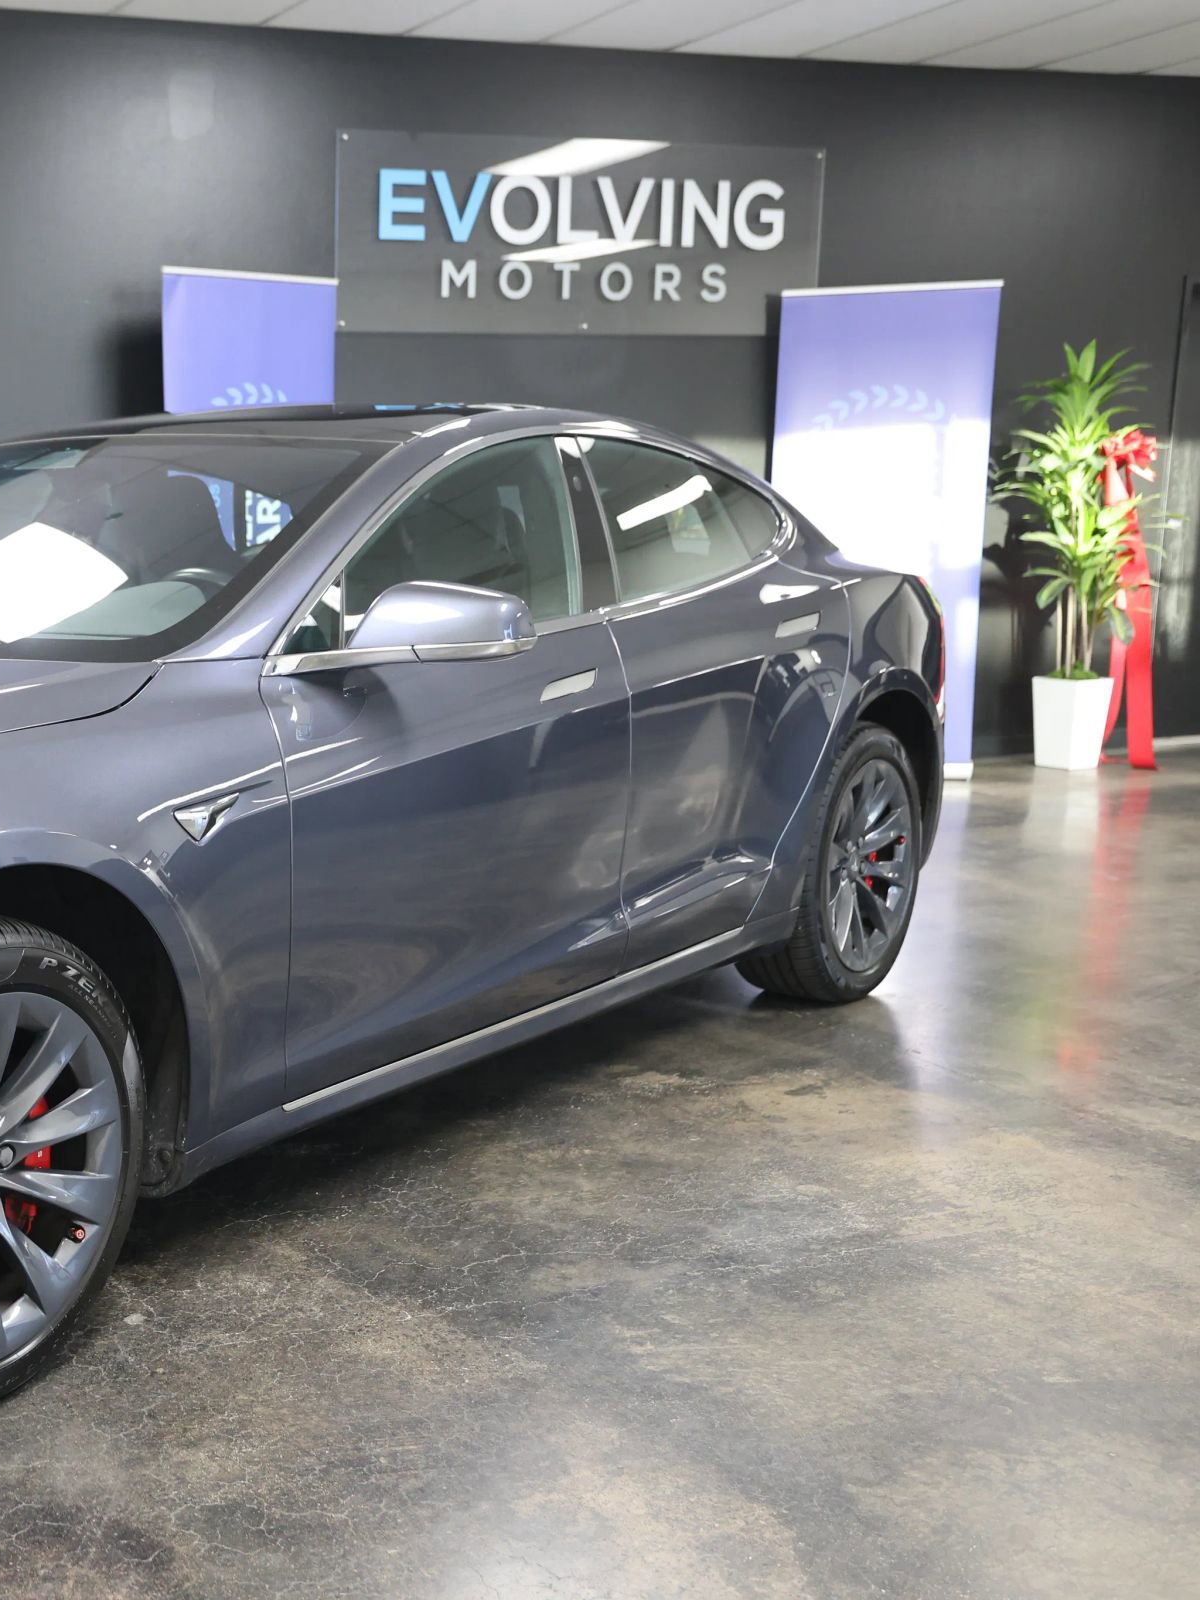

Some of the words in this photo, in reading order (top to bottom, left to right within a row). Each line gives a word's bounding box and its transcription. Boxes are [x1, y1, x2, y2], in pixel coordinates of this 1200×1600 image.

[379, 168, 785, 251] EVOLVING
[441, 259, 727, 303] MOTORS
[39, 956, 58, 970] P
